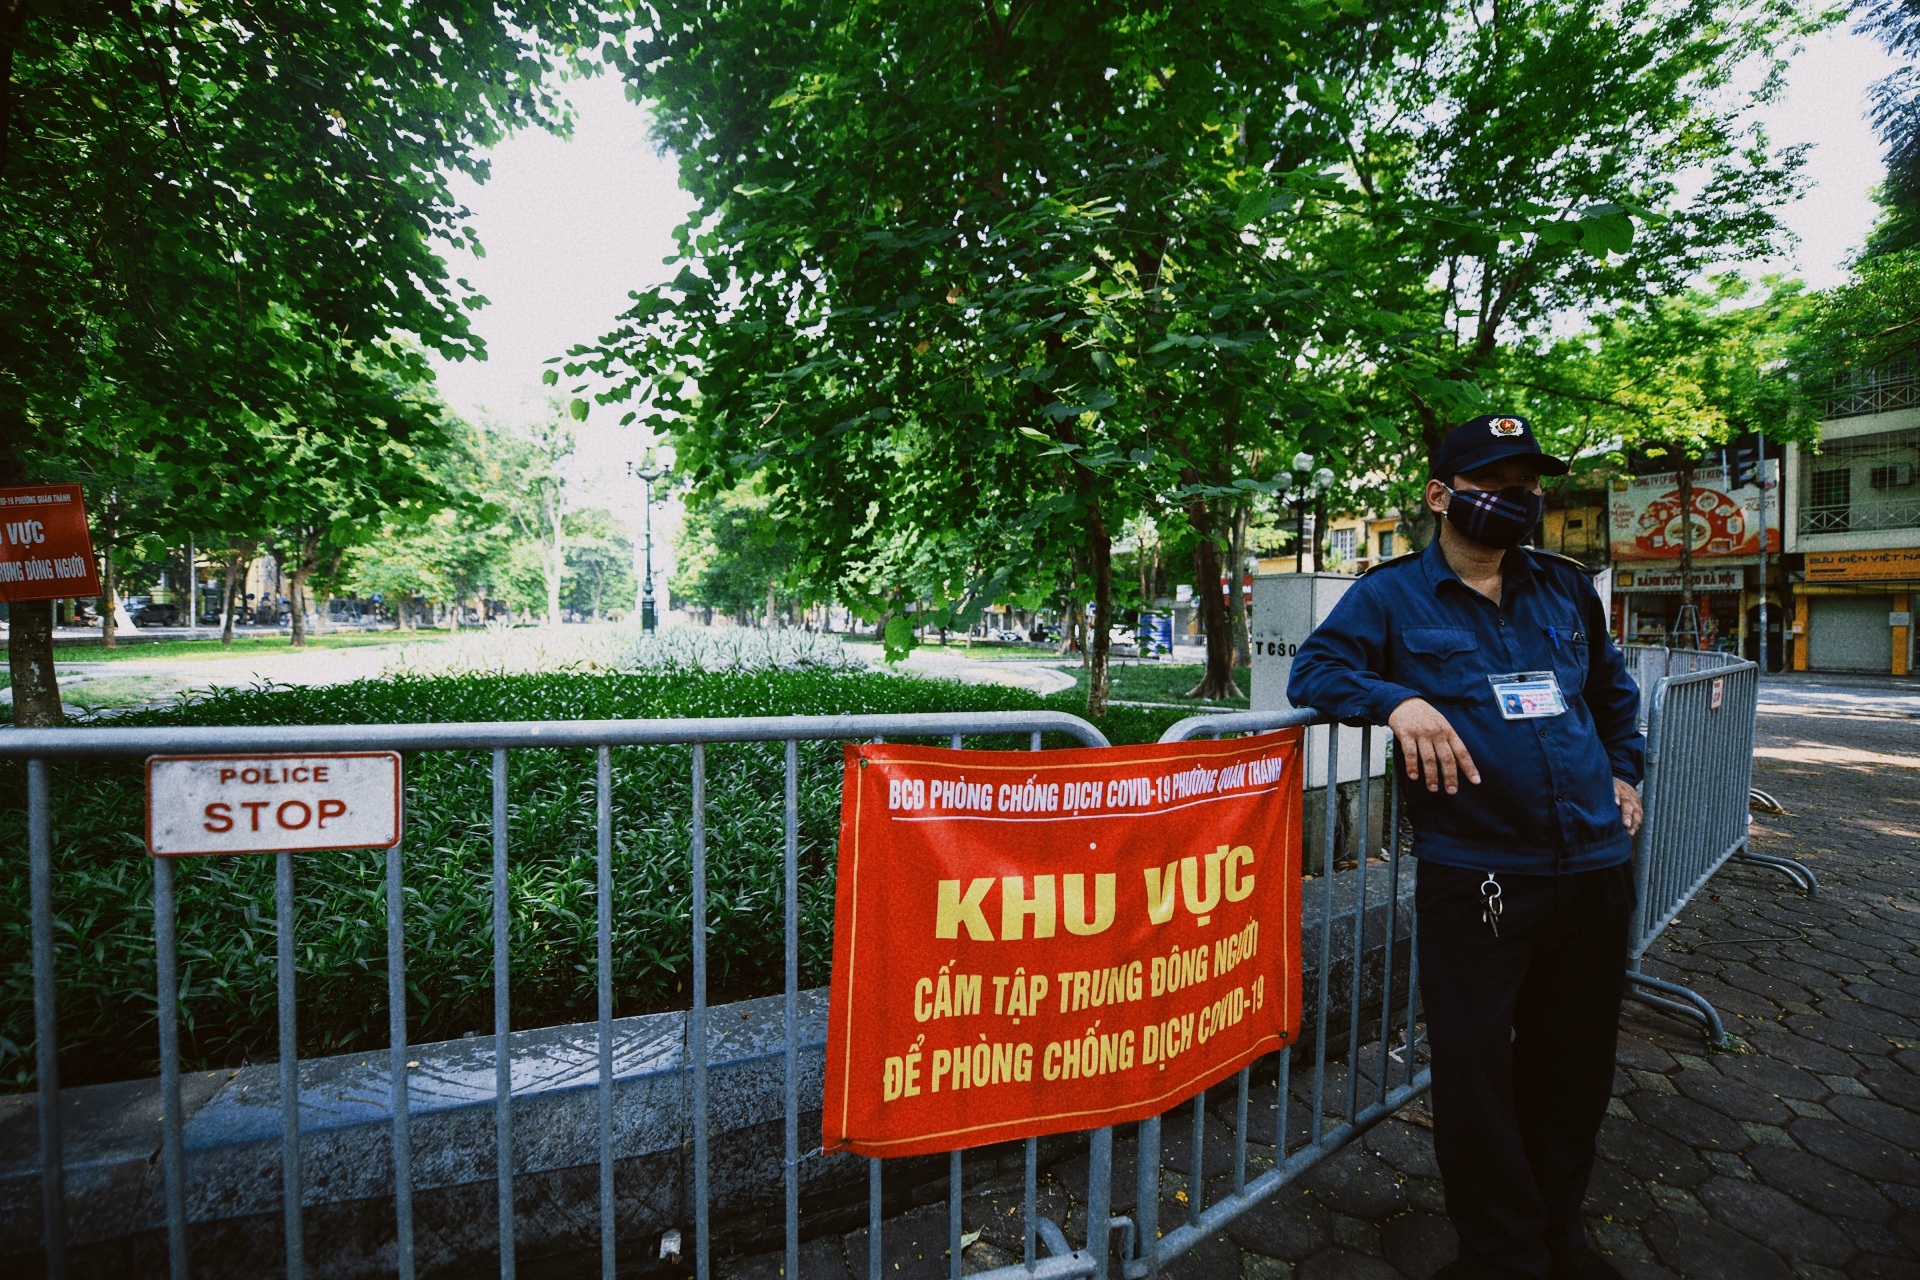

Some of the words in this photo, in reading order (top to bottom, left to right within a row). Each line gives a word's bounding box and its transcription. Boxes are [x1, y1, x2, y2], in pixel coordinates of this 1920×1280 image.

[6, 519, 45, 549] VỰC
[25, 556, 54, 581] ĐÔNG
[54, 552, 87, 579] NGƯỜI
[1810, 556, 1834, 565] BƯU
[1838, 554, 1867, 564] ĐIỆN
[1870, 553, 1900, 563] VIỆT
[220, 766, 329, 785] POLICE
[889, 779, 925, 810] BCĐ
[929, 775, 993, 811] PHÒNG
[998, 774, 1059, 812] CHỐNG
[1063, 782, 1103, 816] DỊCH
[1106, 775, 1171, 808] COVID-19
[1172, 763, 1218, 801] PHƯỜNG
[1217, 759, 1246, 794] QUÁN
[1248, 754, 1282, 786] THÁNH
[203, 799, 347, 833] STOP
[935, 872, 1117, 942] KHU
[1143, 844, 1256, 927] VỰC
[914, 959, 982, 1023] CẤM
[992, 966, 1048, 1025] TẬP
[1057, 960, 1143, 1014] TRUNG
[1150, 944, 1208, 998] ĐÔNG
[1213, 915, 1259, 978] NGƯỜI
[883, 1033, 926, 1103] ĐỂ
[931, 1033, 1034, 1093] PHÒNG
[1042, 1019, 1135, 1081] CHỐNG
[1142, 1012, 1195, 1071] DỊCH
[1197, 974, 1265, 1044] COVID-19
